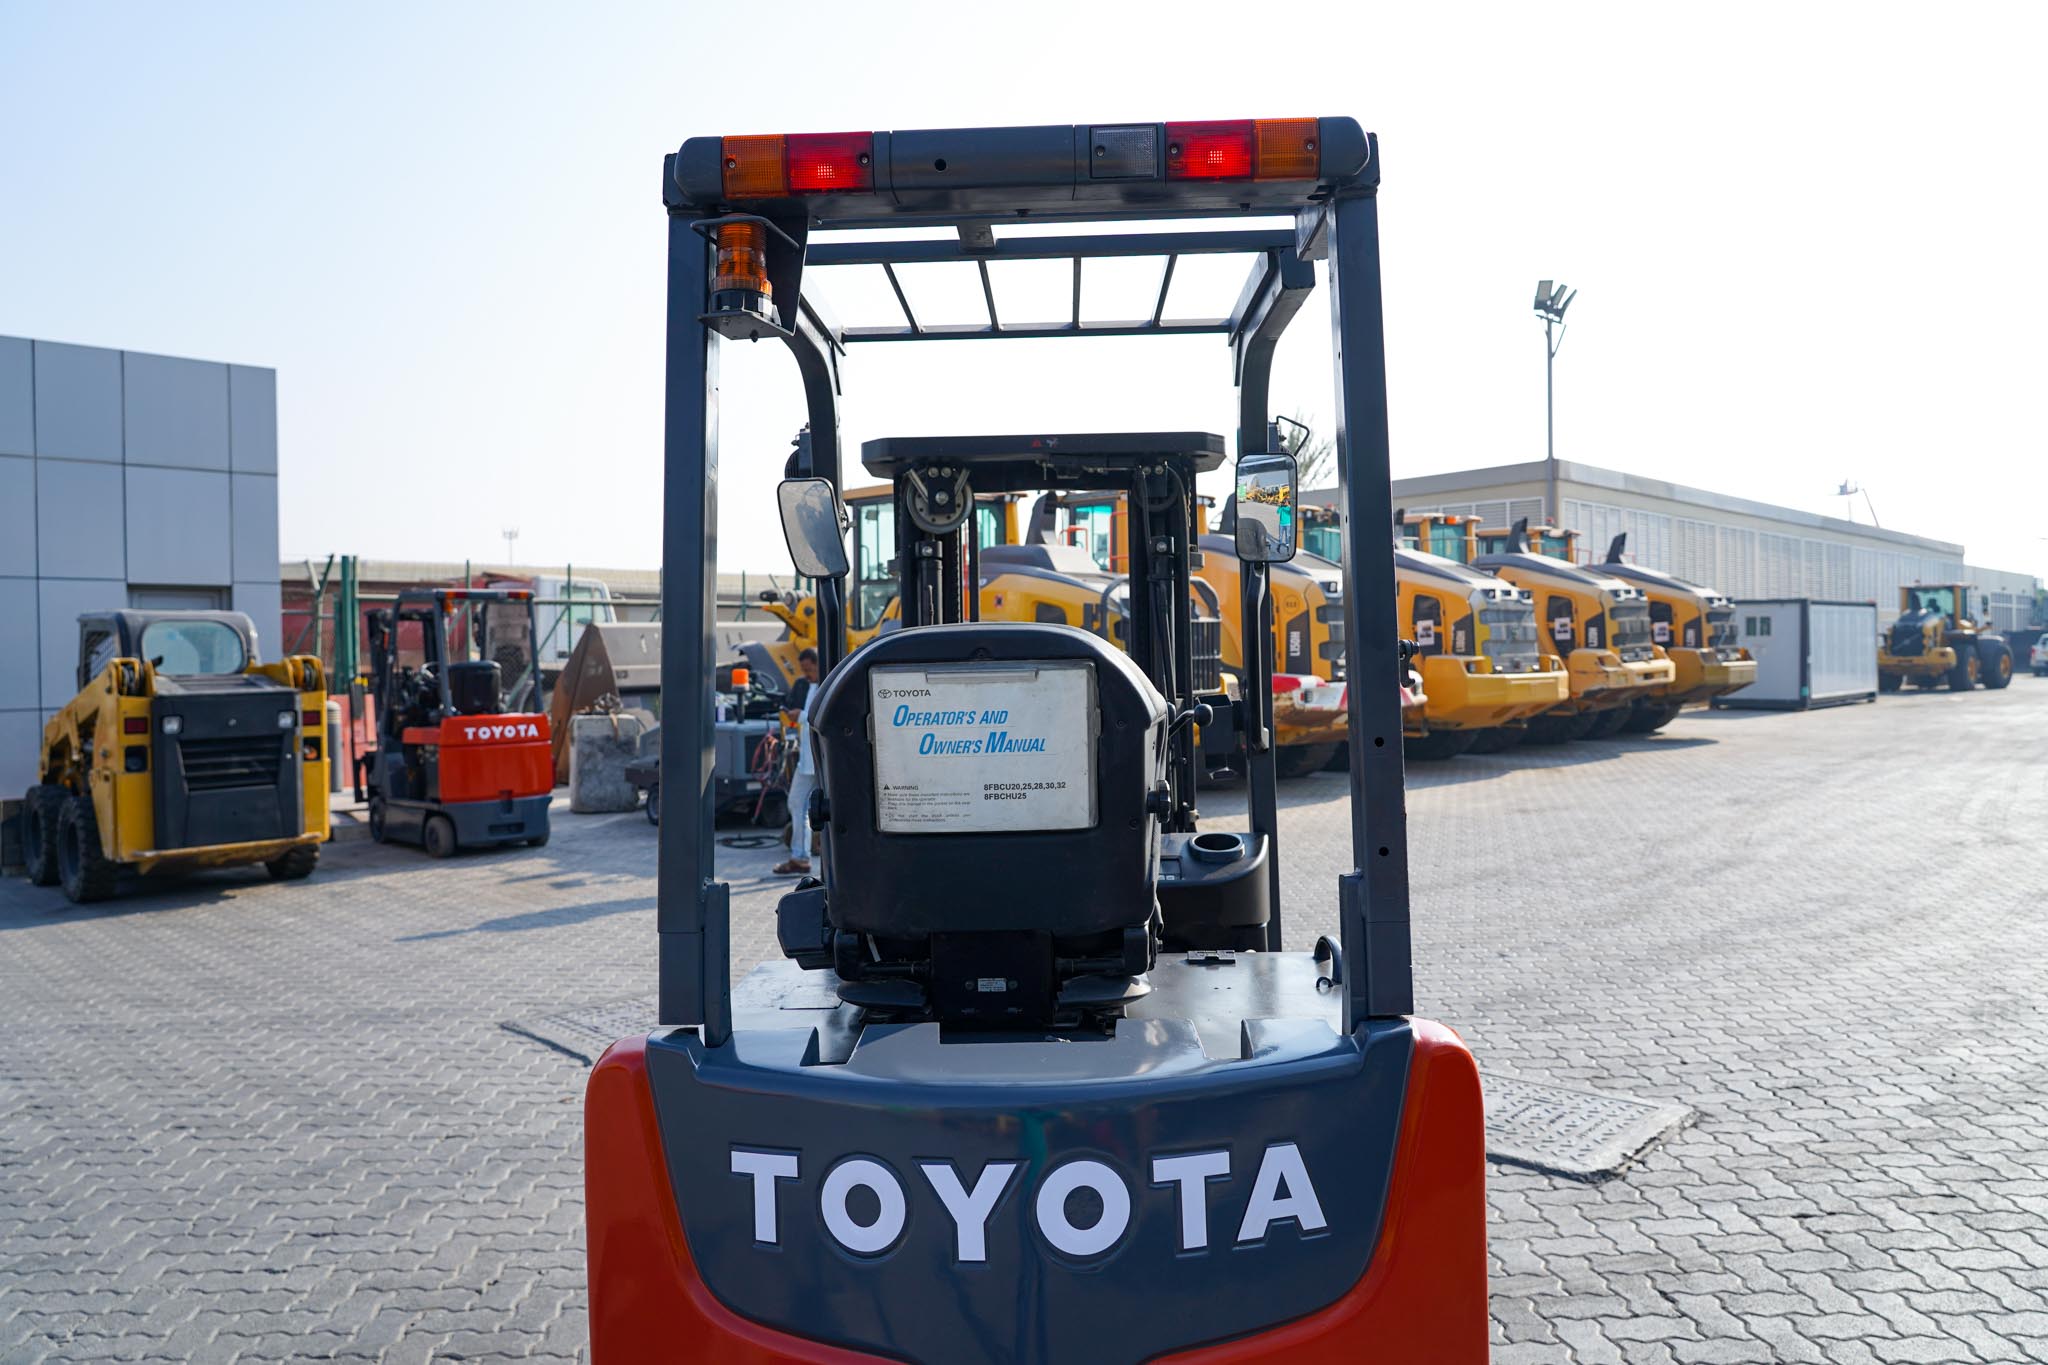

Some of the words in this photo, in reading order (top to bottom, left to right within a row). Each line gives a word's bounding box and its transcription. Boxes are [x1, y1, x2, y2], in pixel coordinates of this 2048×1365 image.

[893, 689, 931, 698] TOYOTA
[892, 704, 976, 727] OPERATOR'S
[979, 709, 1009, 725] AND
[464, 723, 539, 740] TOYOTA
[918, 732, 982, 756] OWNER'S
[984, 731, 1046, 754] MANUAL
[983, 781, 1066, 792] 8FBCU20,25,28,30,32
[983, 792, 1027, 801] 8FBCHU25
[731, 1143, 1328, 1262] TOYOTA
